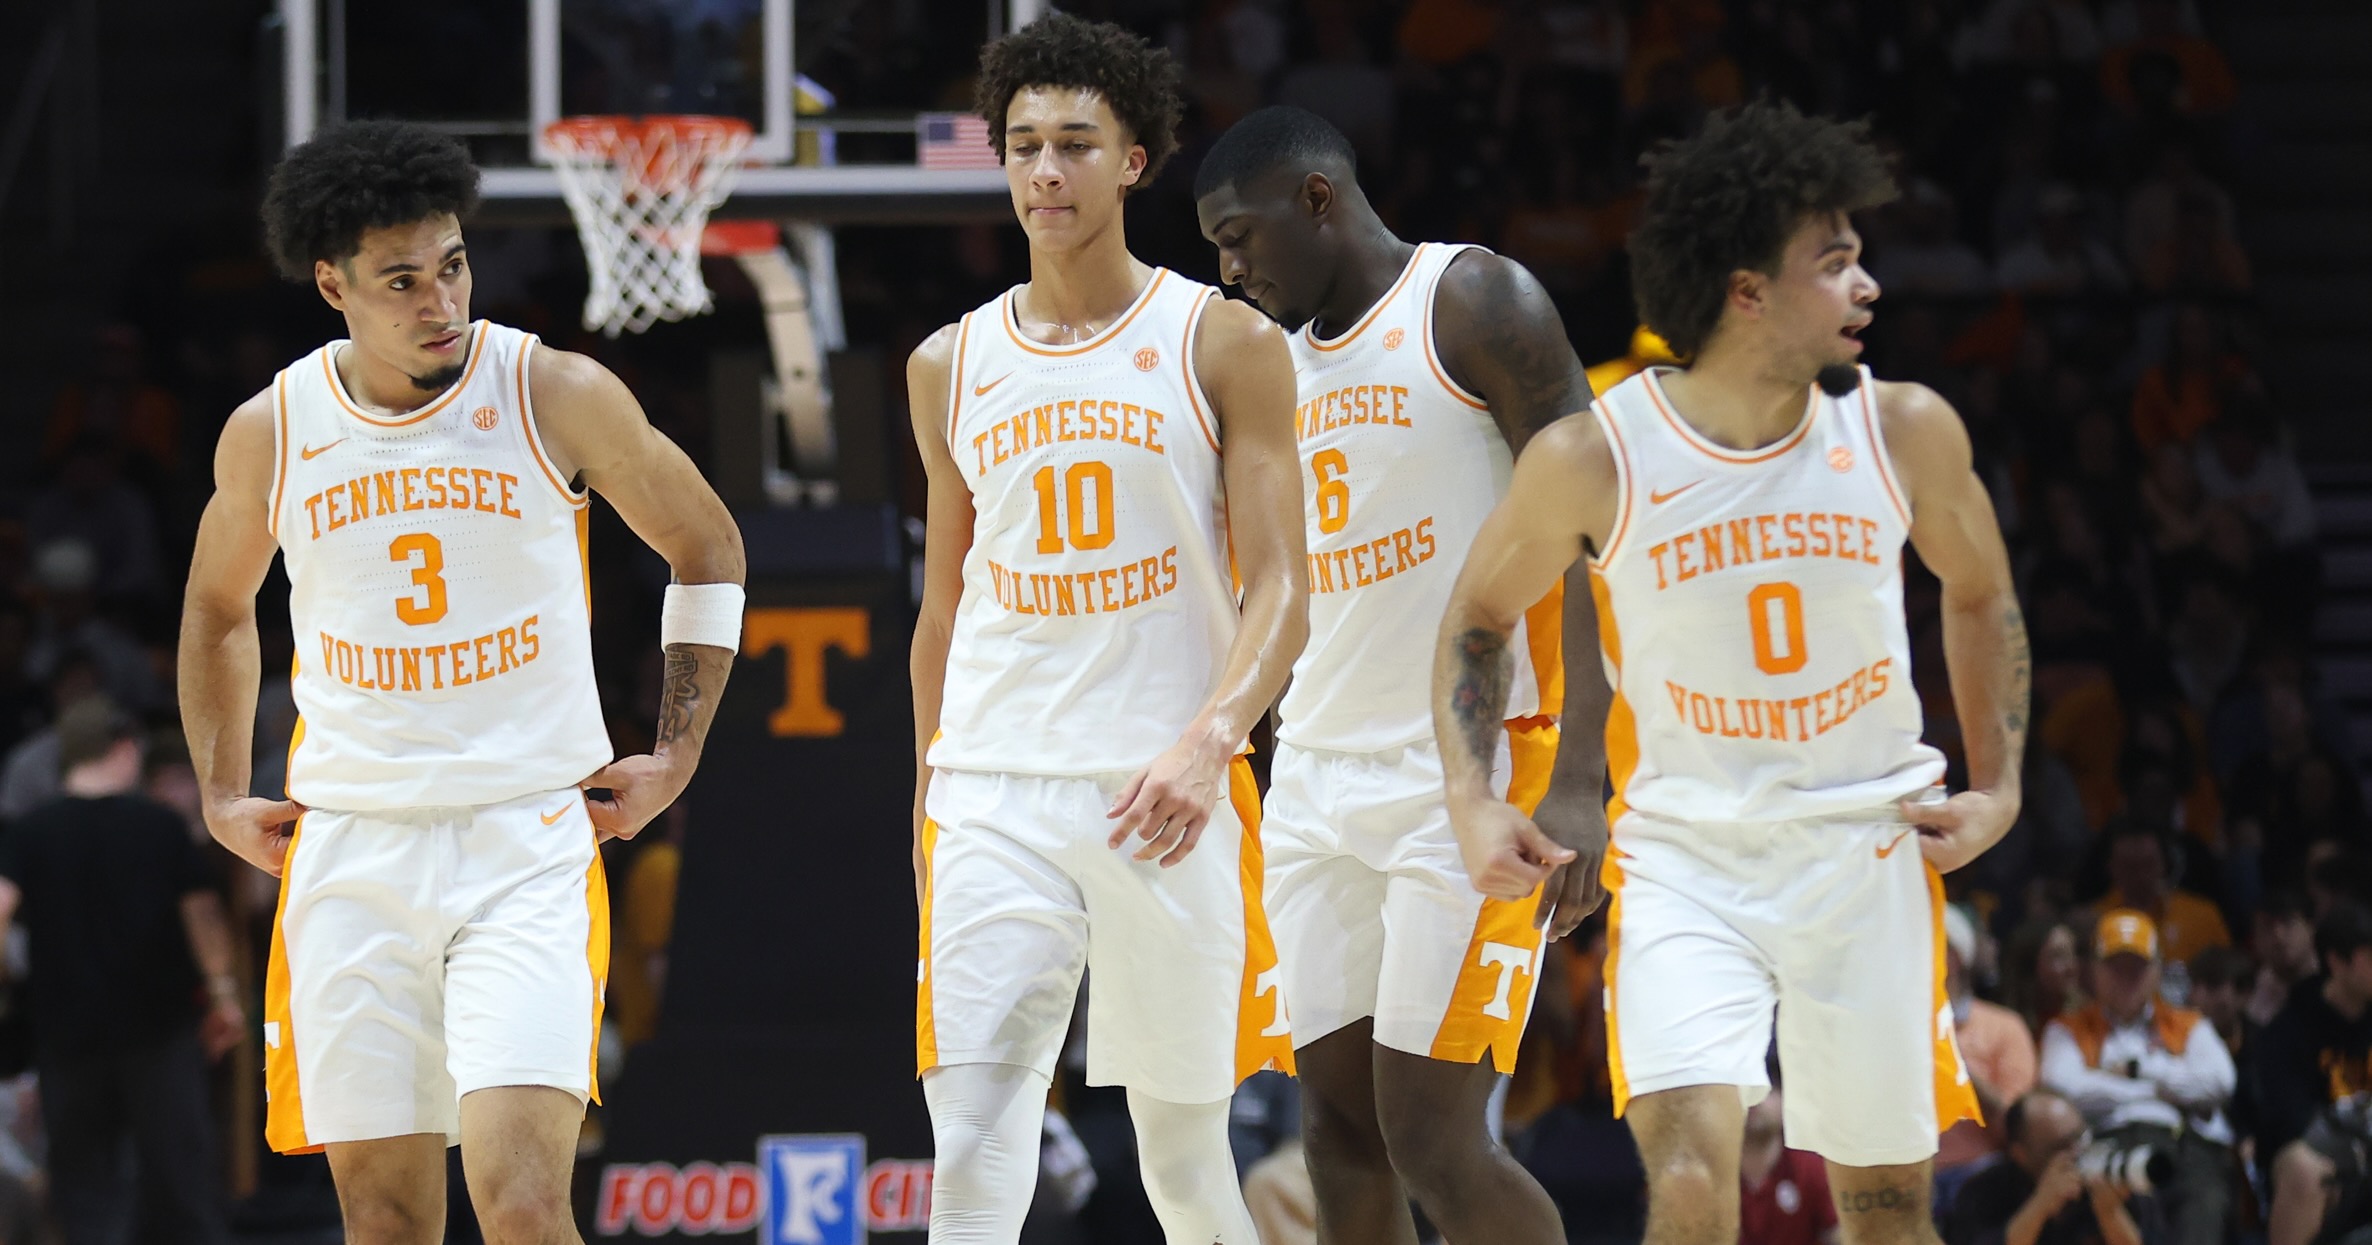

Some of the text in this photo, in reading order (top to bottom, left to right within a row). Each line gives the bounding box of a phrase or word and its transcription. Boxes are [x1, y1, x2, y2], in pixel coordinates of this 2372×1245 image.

[475, 409, 496, 428] SEC
[973, 400, 1165, 477] TENNESSEE
[304, 467, 522, 541] TENNESSEE
[1033, 460, 1115, 555] 10
[1311, 448, 1349, 535] 6
[389, 532, 449, 627] 3
[988, 545, 1177, 617] VOLUNTEERS
[1649, 512, 1880, 591] TENNESSEE
[320, 614, 541, 692] VOLUNTEERS
[1746, 581, 1809, 676] 0
[741, 607, 870, 737] T
[1664, 657, 1893, 742] VOLUNTEERS
[1479, 941, 1534, 1021] T
[604, 1170, 760, 1226] FOOD
[864, 1164, 934, 1228] CI
